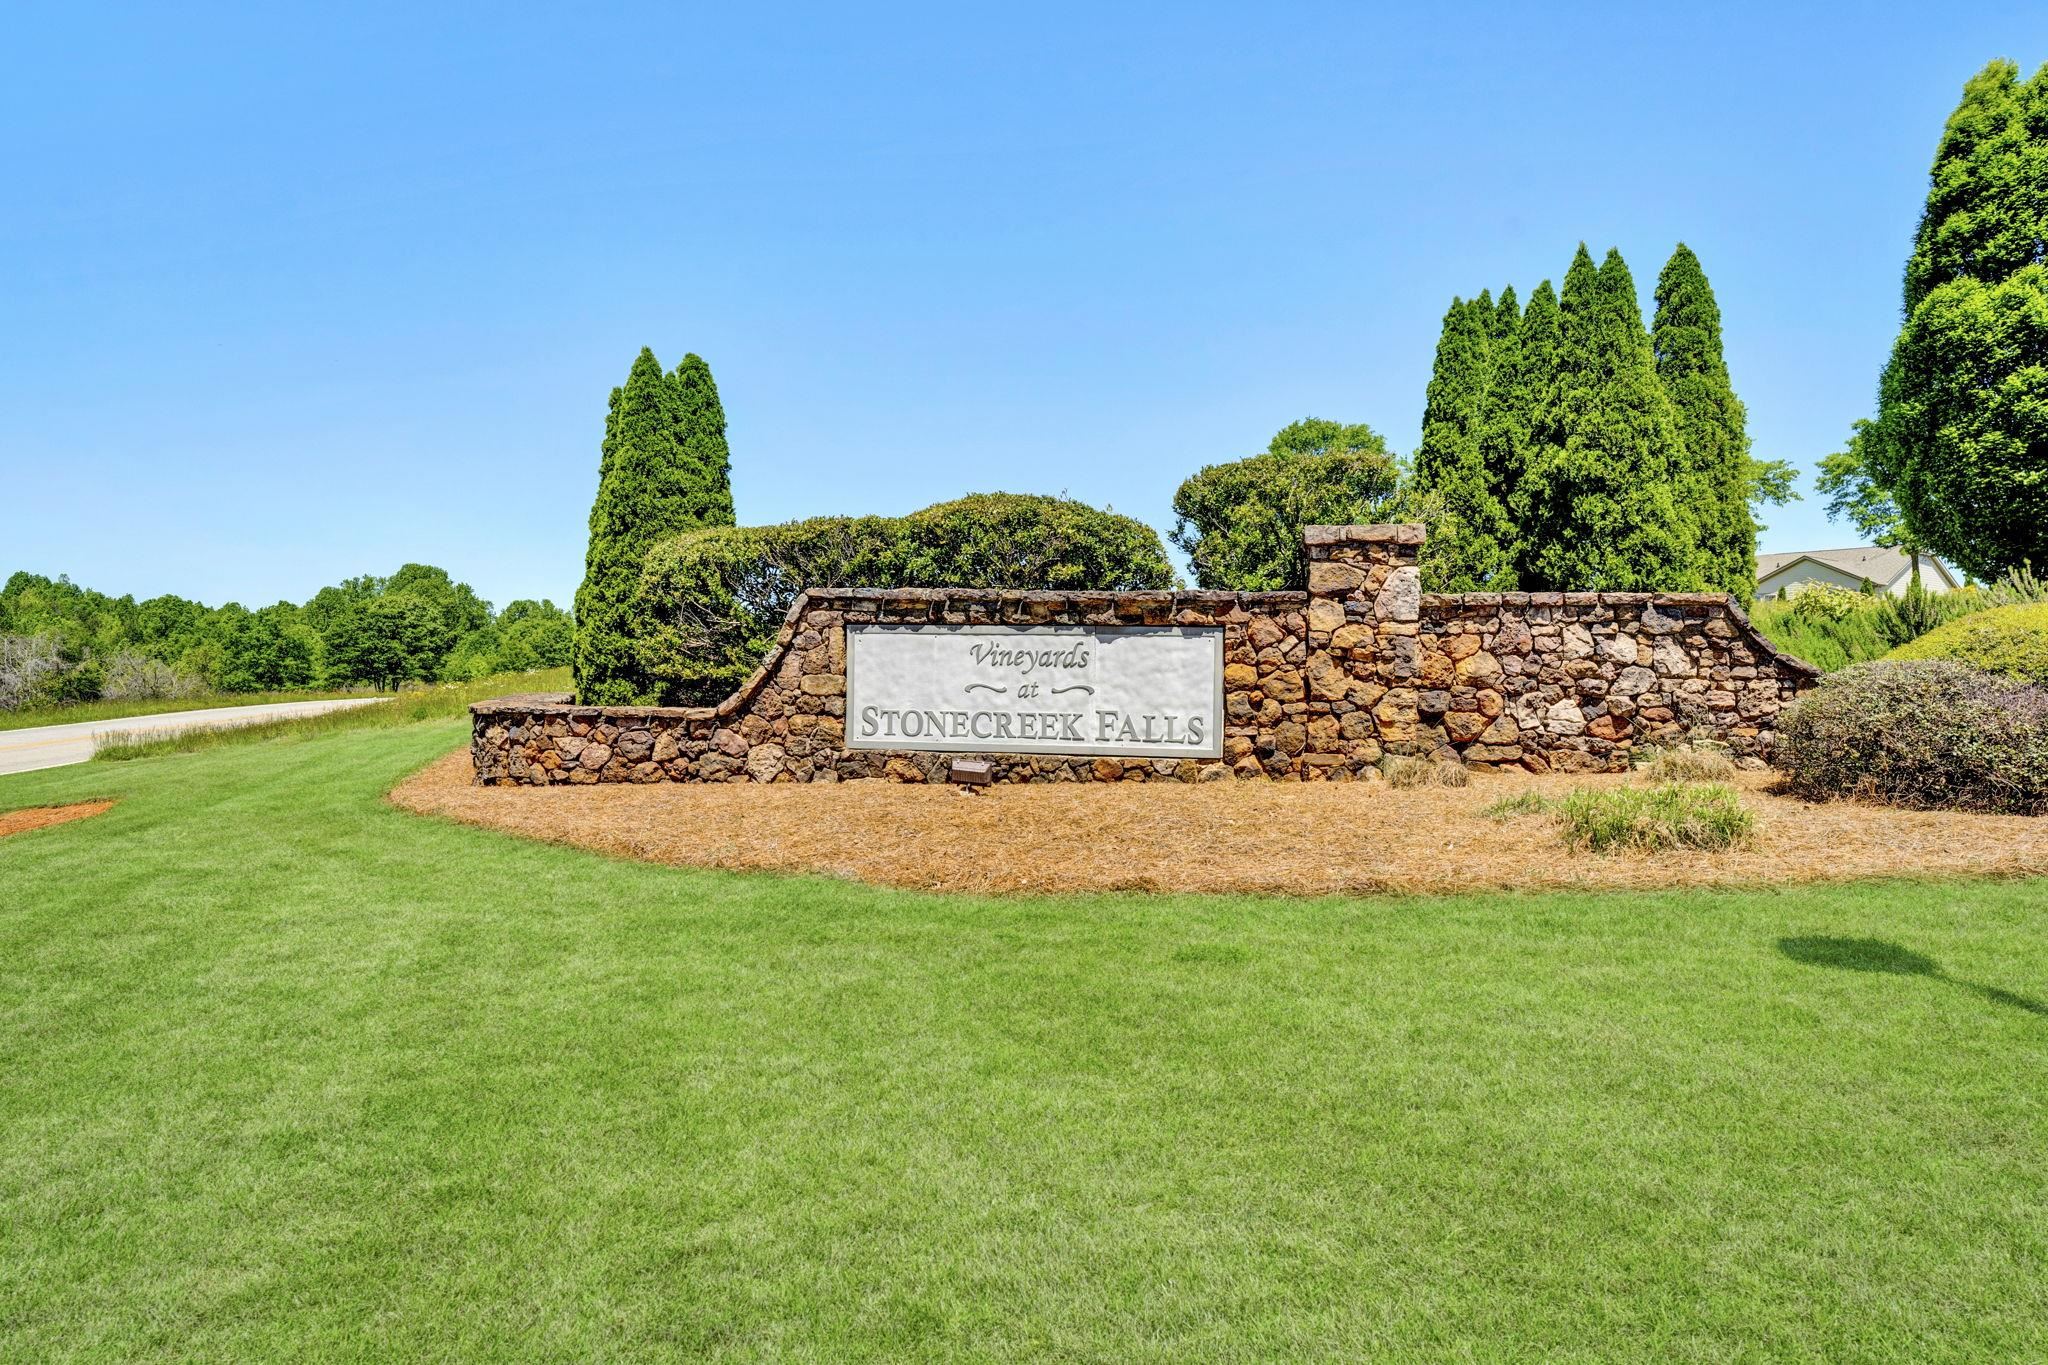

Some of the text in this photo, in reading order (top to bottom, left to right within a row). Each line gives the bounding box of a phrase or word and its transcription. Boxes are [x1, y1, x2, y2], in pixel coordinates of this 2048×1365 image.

[969, 640, 1090, 675] Vineyards
[1017, 679, 1040, 699] at
[860, 705, 1205, 745] STONECREEK FALLS
